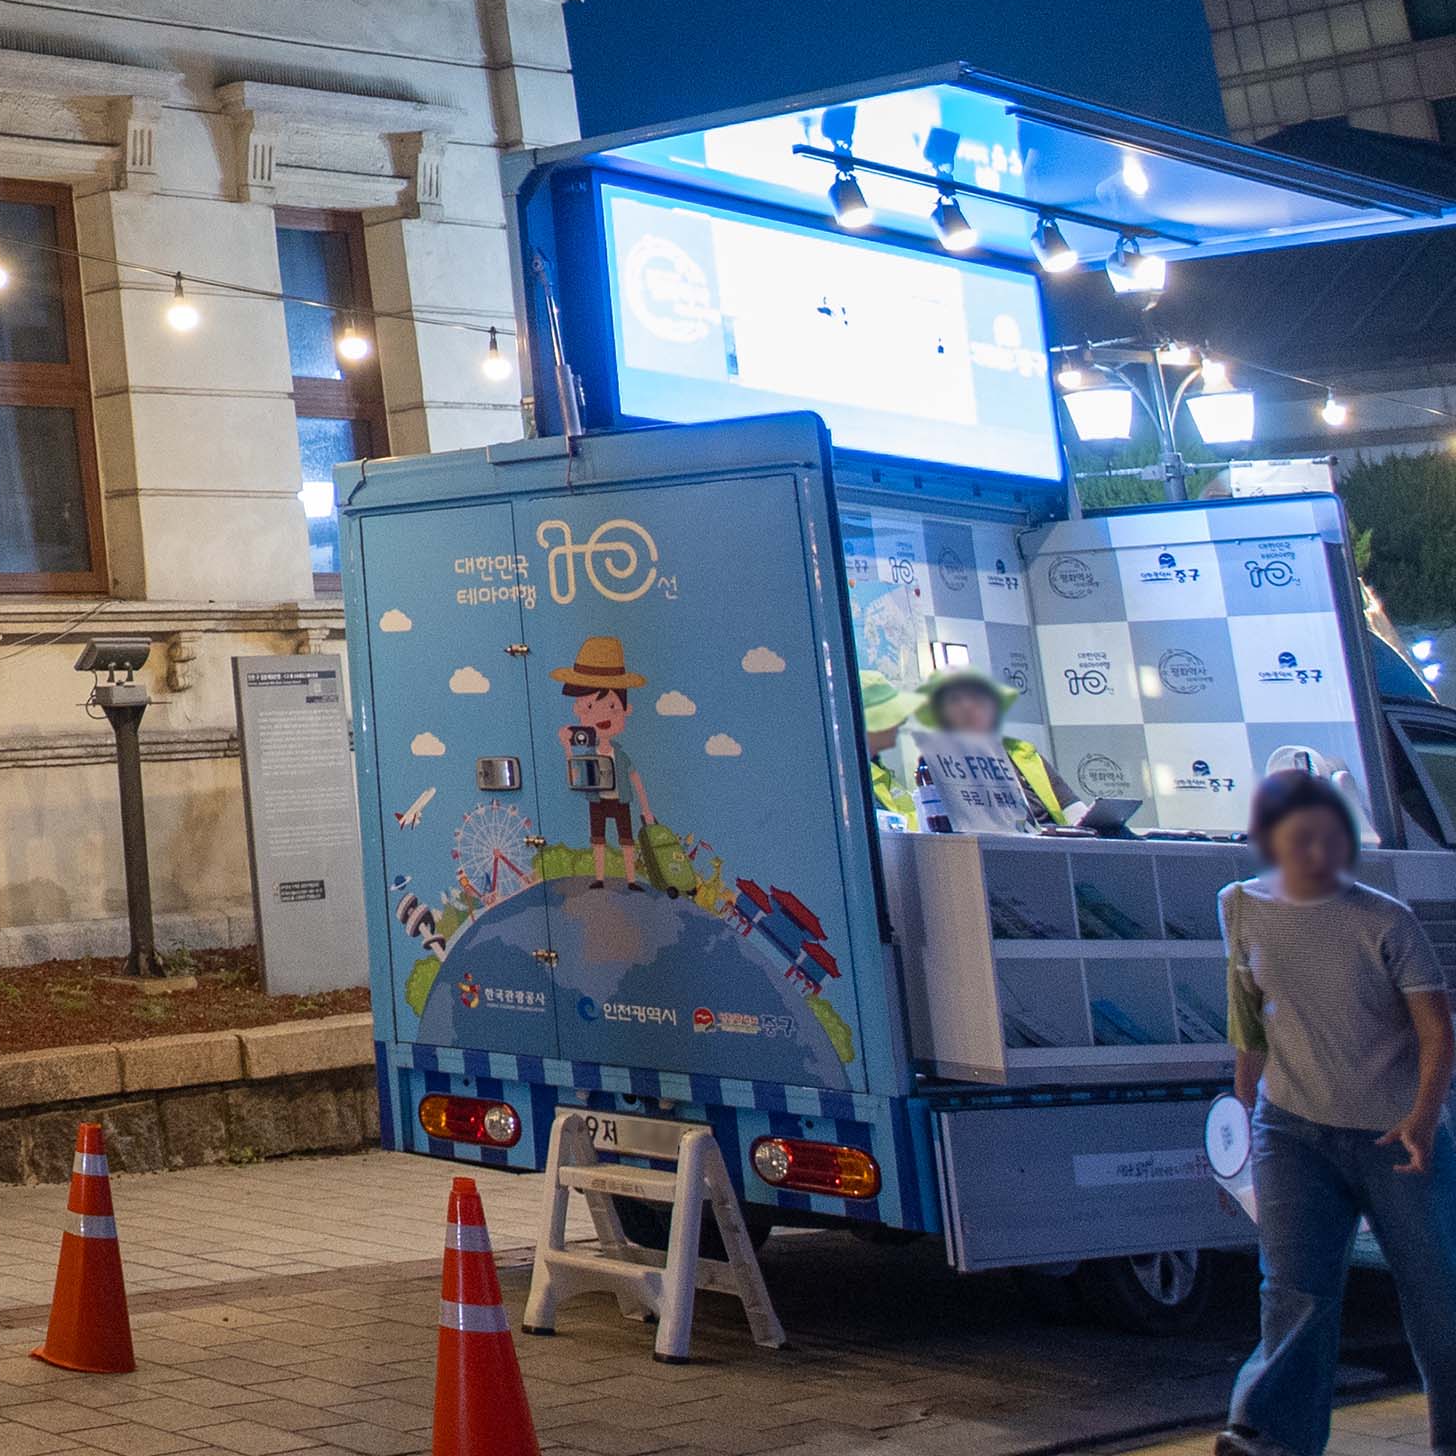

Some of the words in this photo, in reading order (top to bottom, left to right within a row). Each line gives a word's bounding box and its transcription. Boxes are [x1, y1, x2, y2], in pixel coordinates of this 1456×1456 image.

[454, 554, 530, 581] 대한민국
[1174, 568, 1201, 584] 중구
[456, 583, 537, 610] 테마여행
[1295, 669, 1324, 684] 중구
[936, 754, 966, 779] It's
[964, 755, 1015, 781] FREE
[1207, 777, 1236, 793] 중구
[960, 789, 985, 806] 무료
[484, 987, 546, 1006] 한국관광공사
[602, 1001, 678, 1027] 인천광역시
[760, 1013, 796, 1038] 중구
